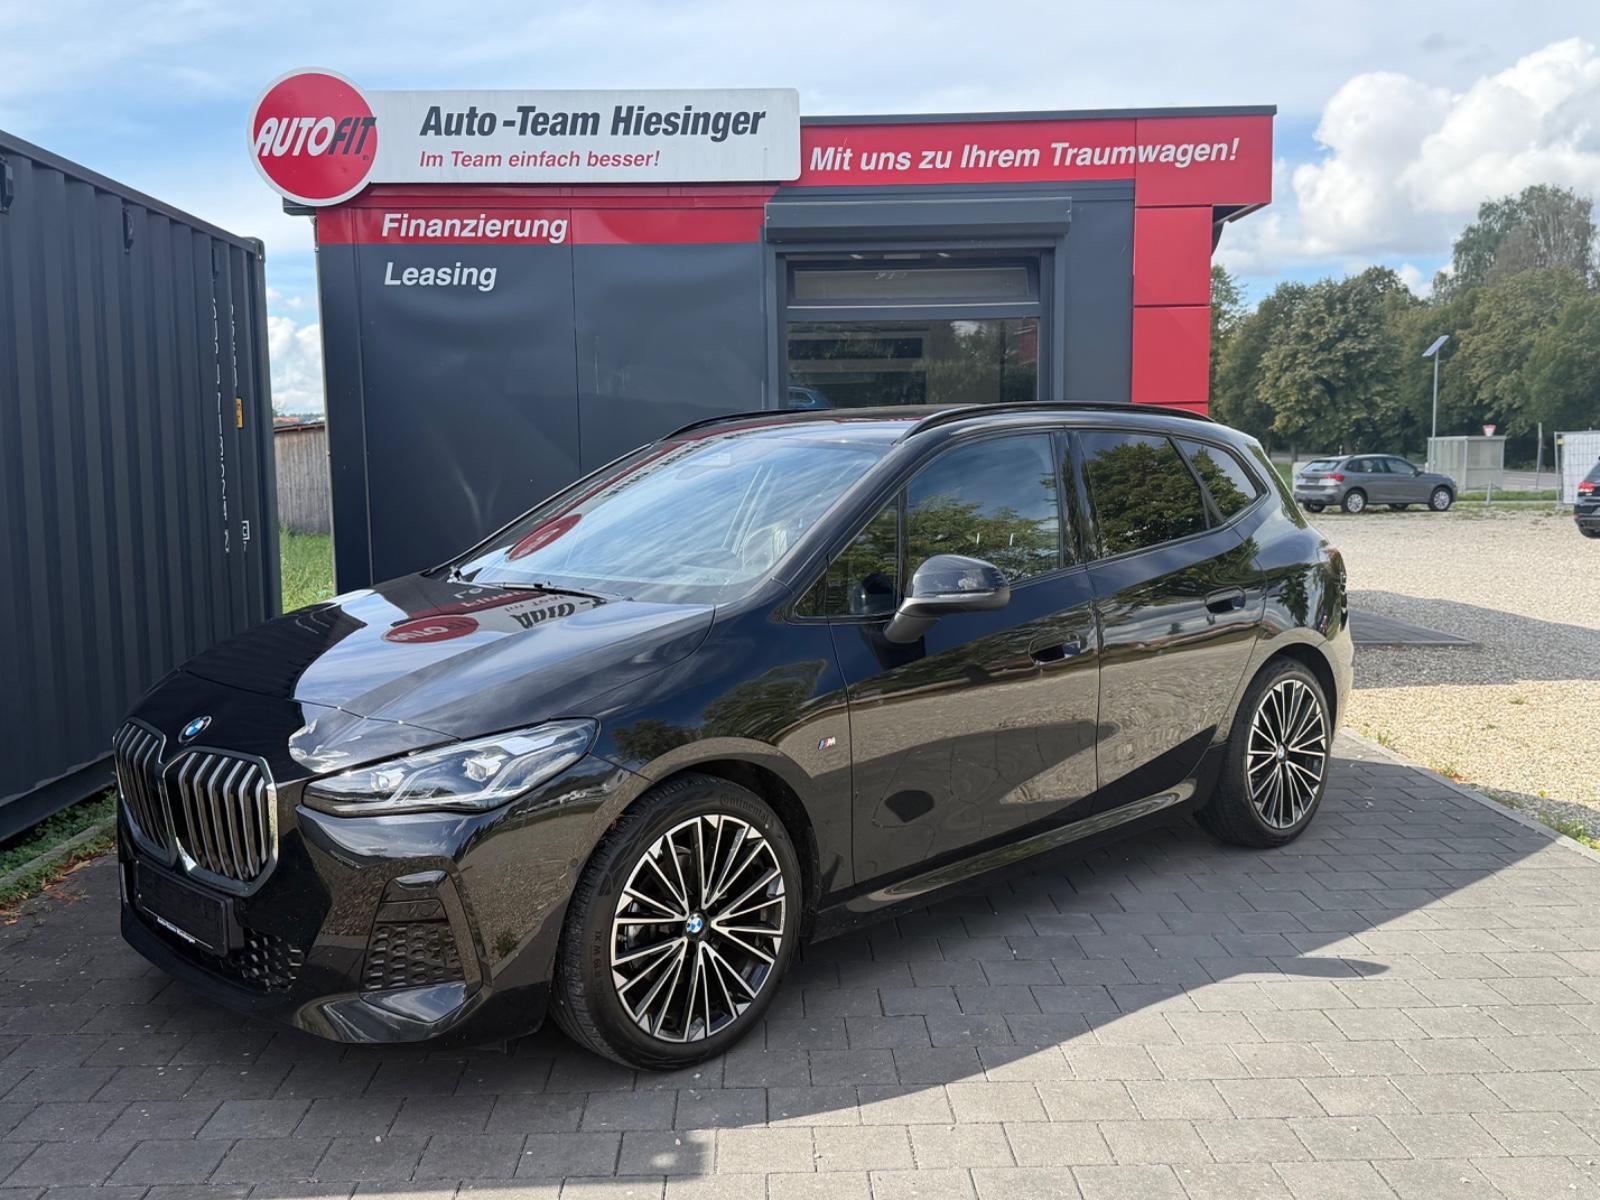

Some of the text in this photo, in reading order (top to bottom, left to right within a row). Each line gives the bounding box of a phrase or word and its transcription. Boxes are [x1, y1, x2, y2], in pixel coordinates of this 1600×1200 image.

[256, 116, 377, 157] AUTOFIT
[610, 105, 767, 143] Hiesinger
[419, 150, 660, 167] Im Team einfach besser!
[809, 137, 1240, 171] Mit uns zu Ihrem Traumwagen!
[381, 213, 568, 244] Finanzierung
[384, 262, 497, 292] Leasing
